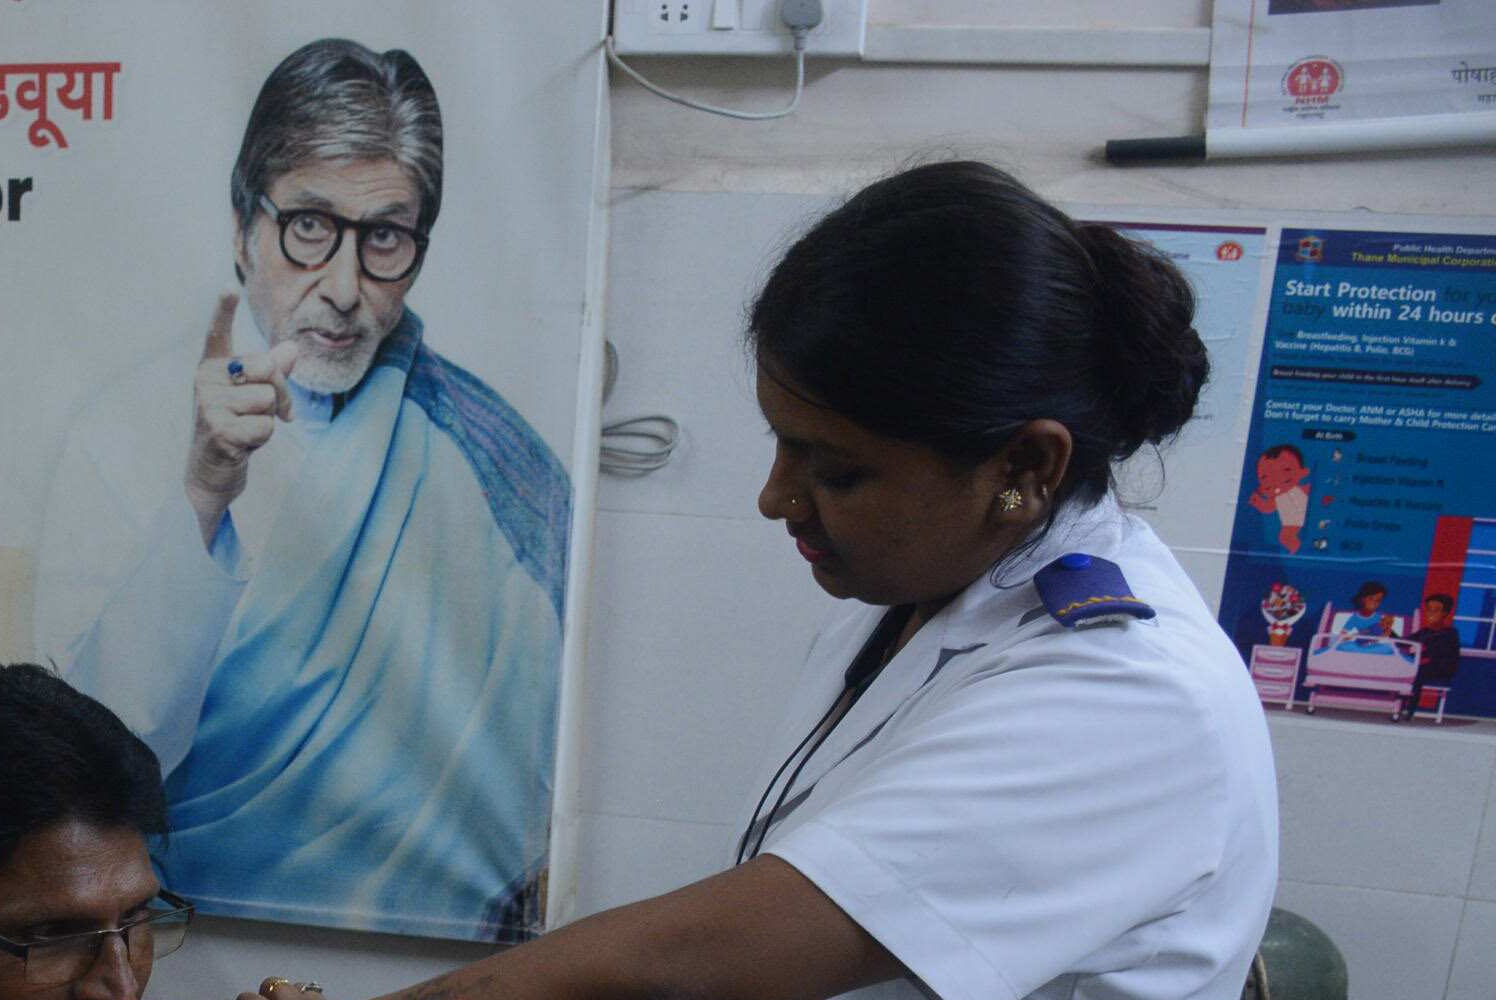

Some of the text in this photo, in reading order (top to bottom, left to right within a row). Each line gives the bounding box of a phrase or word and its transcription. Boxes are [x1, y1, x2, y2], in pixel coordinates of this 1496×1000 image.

[1352, 251, 1384, 264] Thane
[1285, 279, 1332, 298] Start
[1337, 281, 1437, 302] Protection
[1332, 303, 1392, 321] within
[1398, 305, 1421, 322] 24
[1429, 306, 1485, 325] hours
